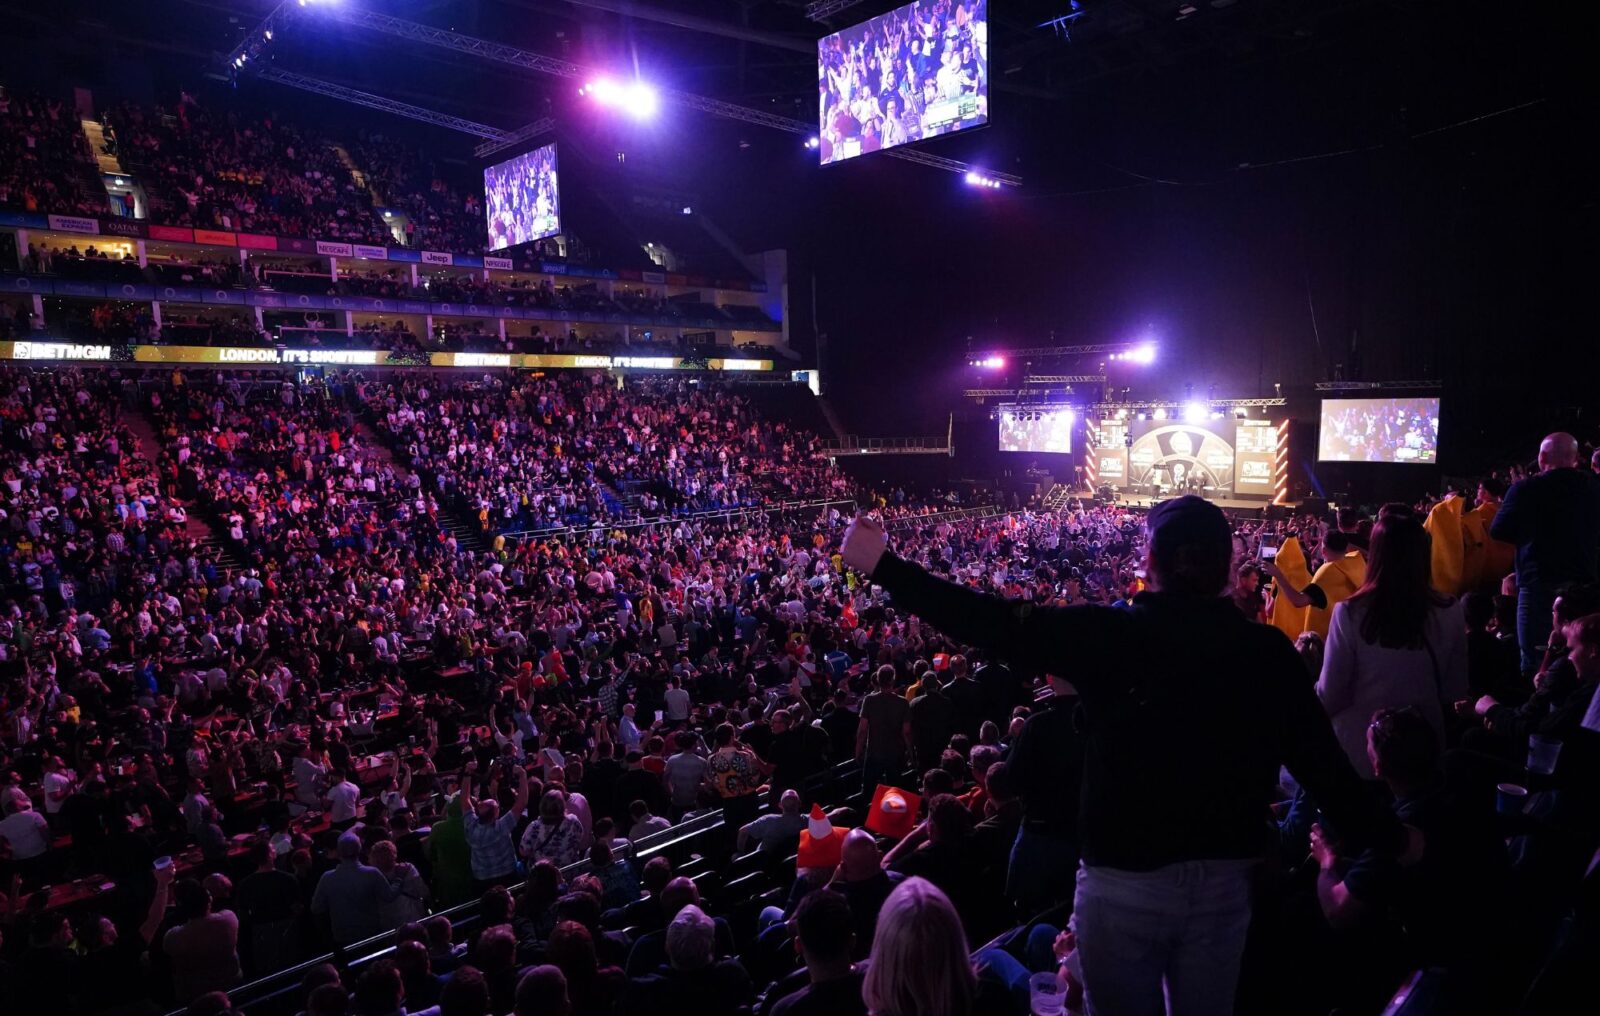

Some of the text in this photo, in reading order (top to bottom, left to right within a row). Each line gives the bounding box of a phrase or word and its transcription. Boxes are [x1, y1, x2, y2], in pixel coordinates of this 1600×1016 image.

[108, 222, 139, 232] QATAR
[427, 254, 449, 263] Jeep
[31, 343, 111, 360] BETMGM
[219, 348, 281, 364] LONDON,
[283, 349, 308, 363] IT'S
